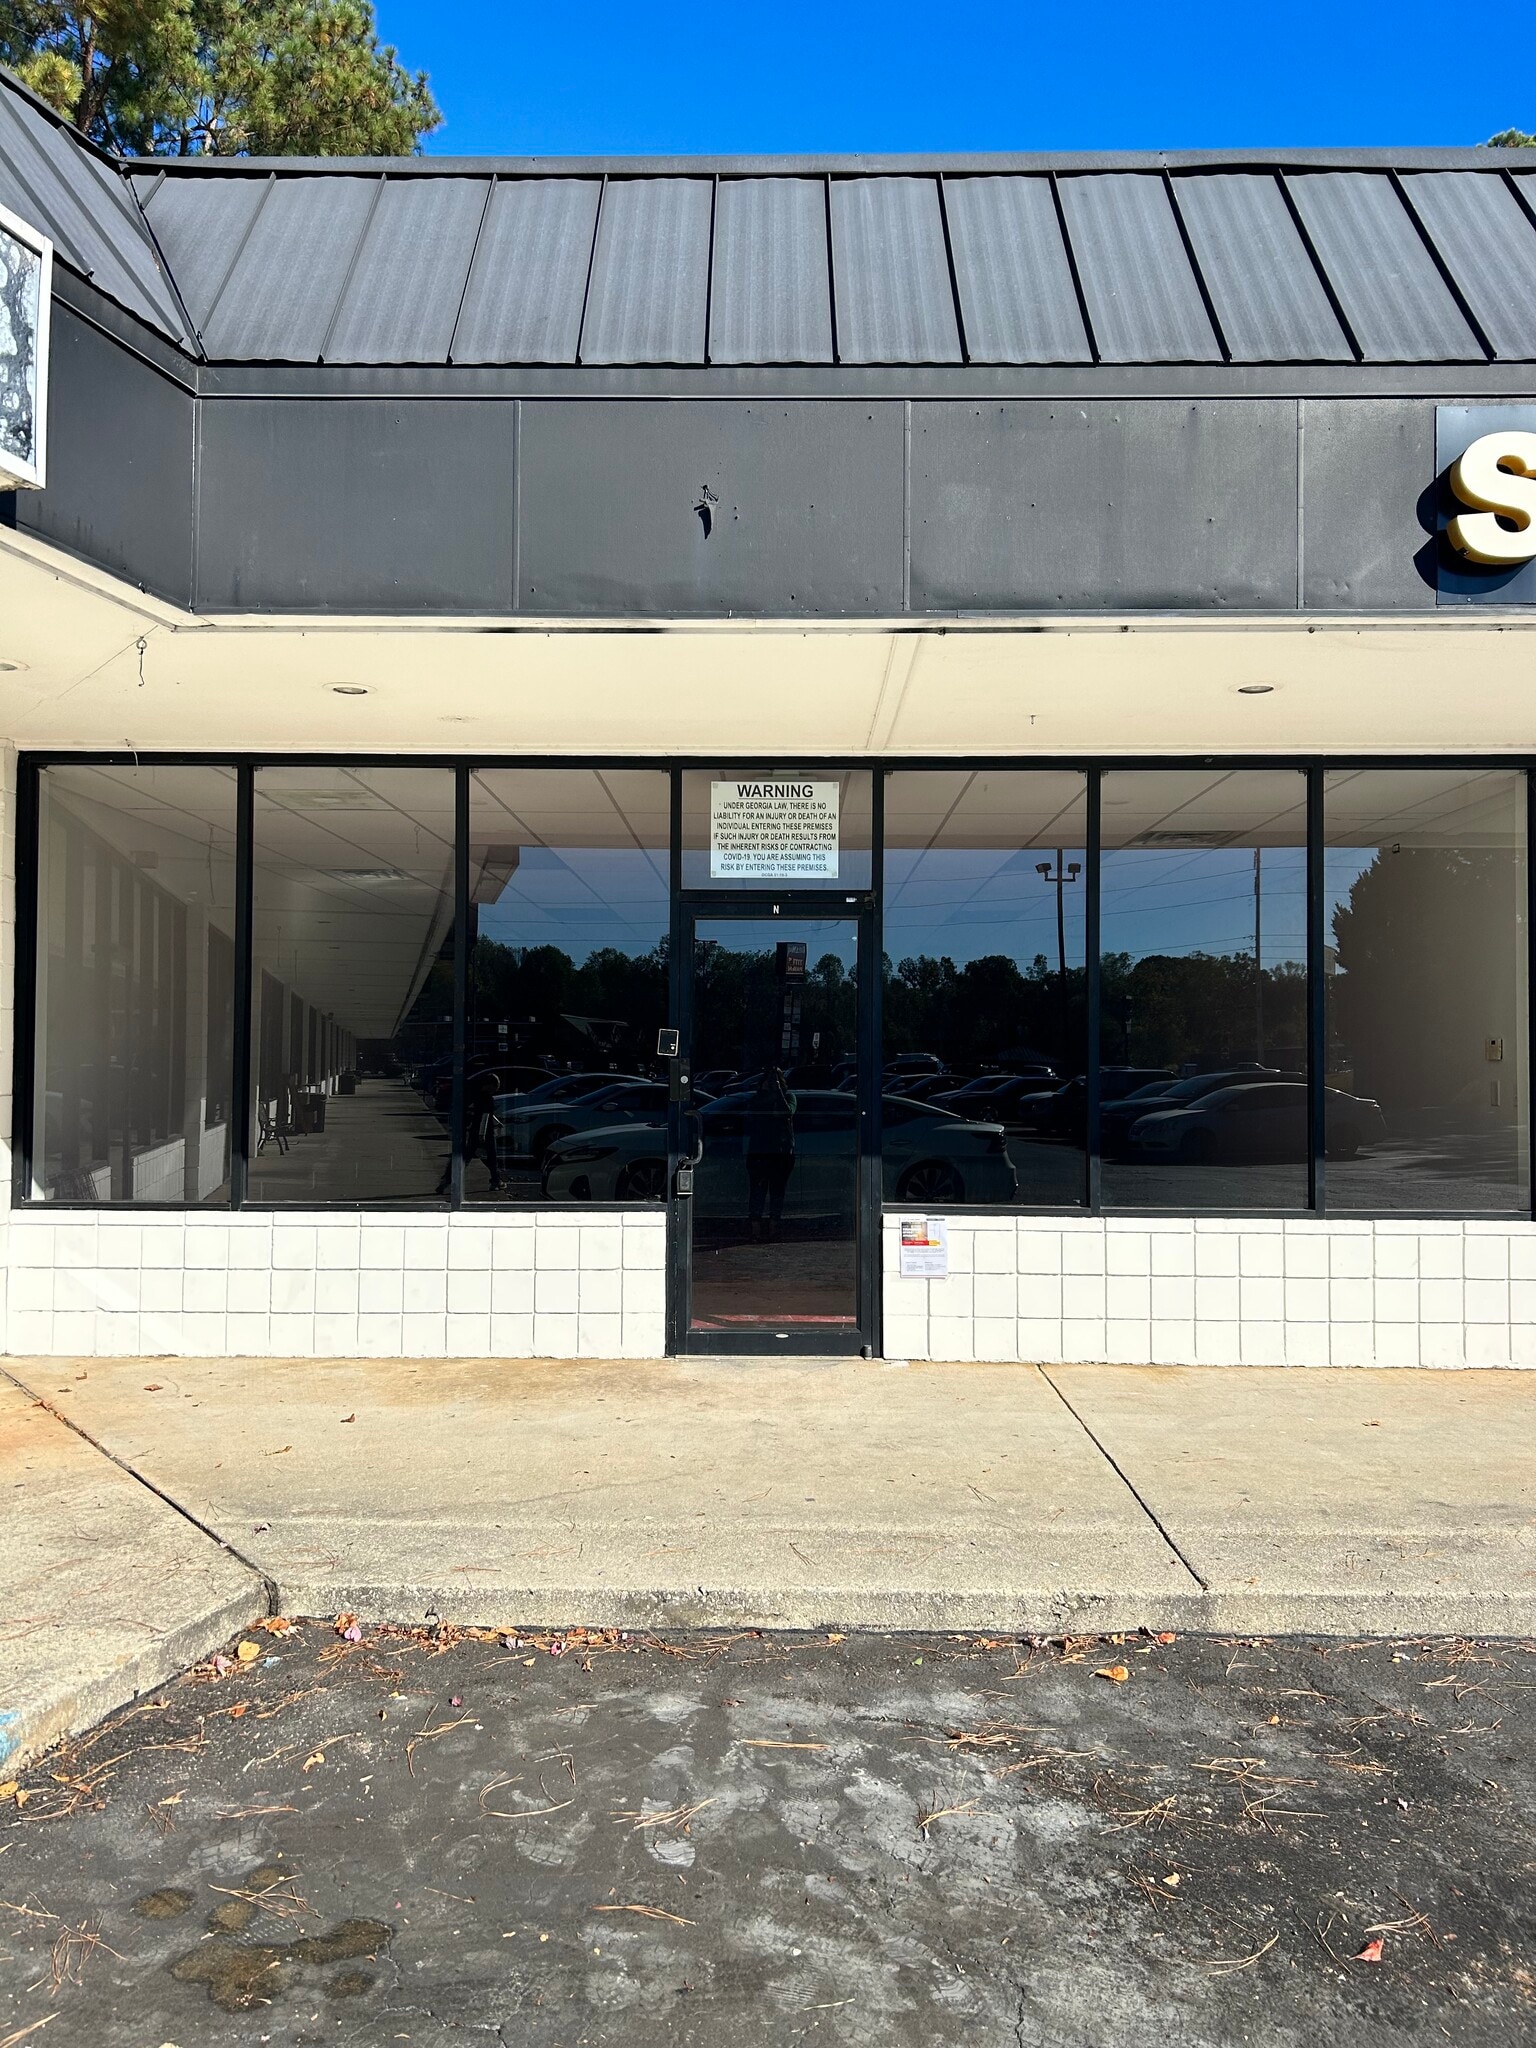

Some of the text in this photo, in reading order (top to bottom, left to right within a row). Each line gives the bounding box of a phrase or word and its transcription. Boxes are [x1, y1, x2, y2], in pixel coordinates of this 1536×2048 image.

[737, 784, 814, 798] WARNING
[774, 802, 788, 811] LAW,
[773, 904, 780, 914] N
